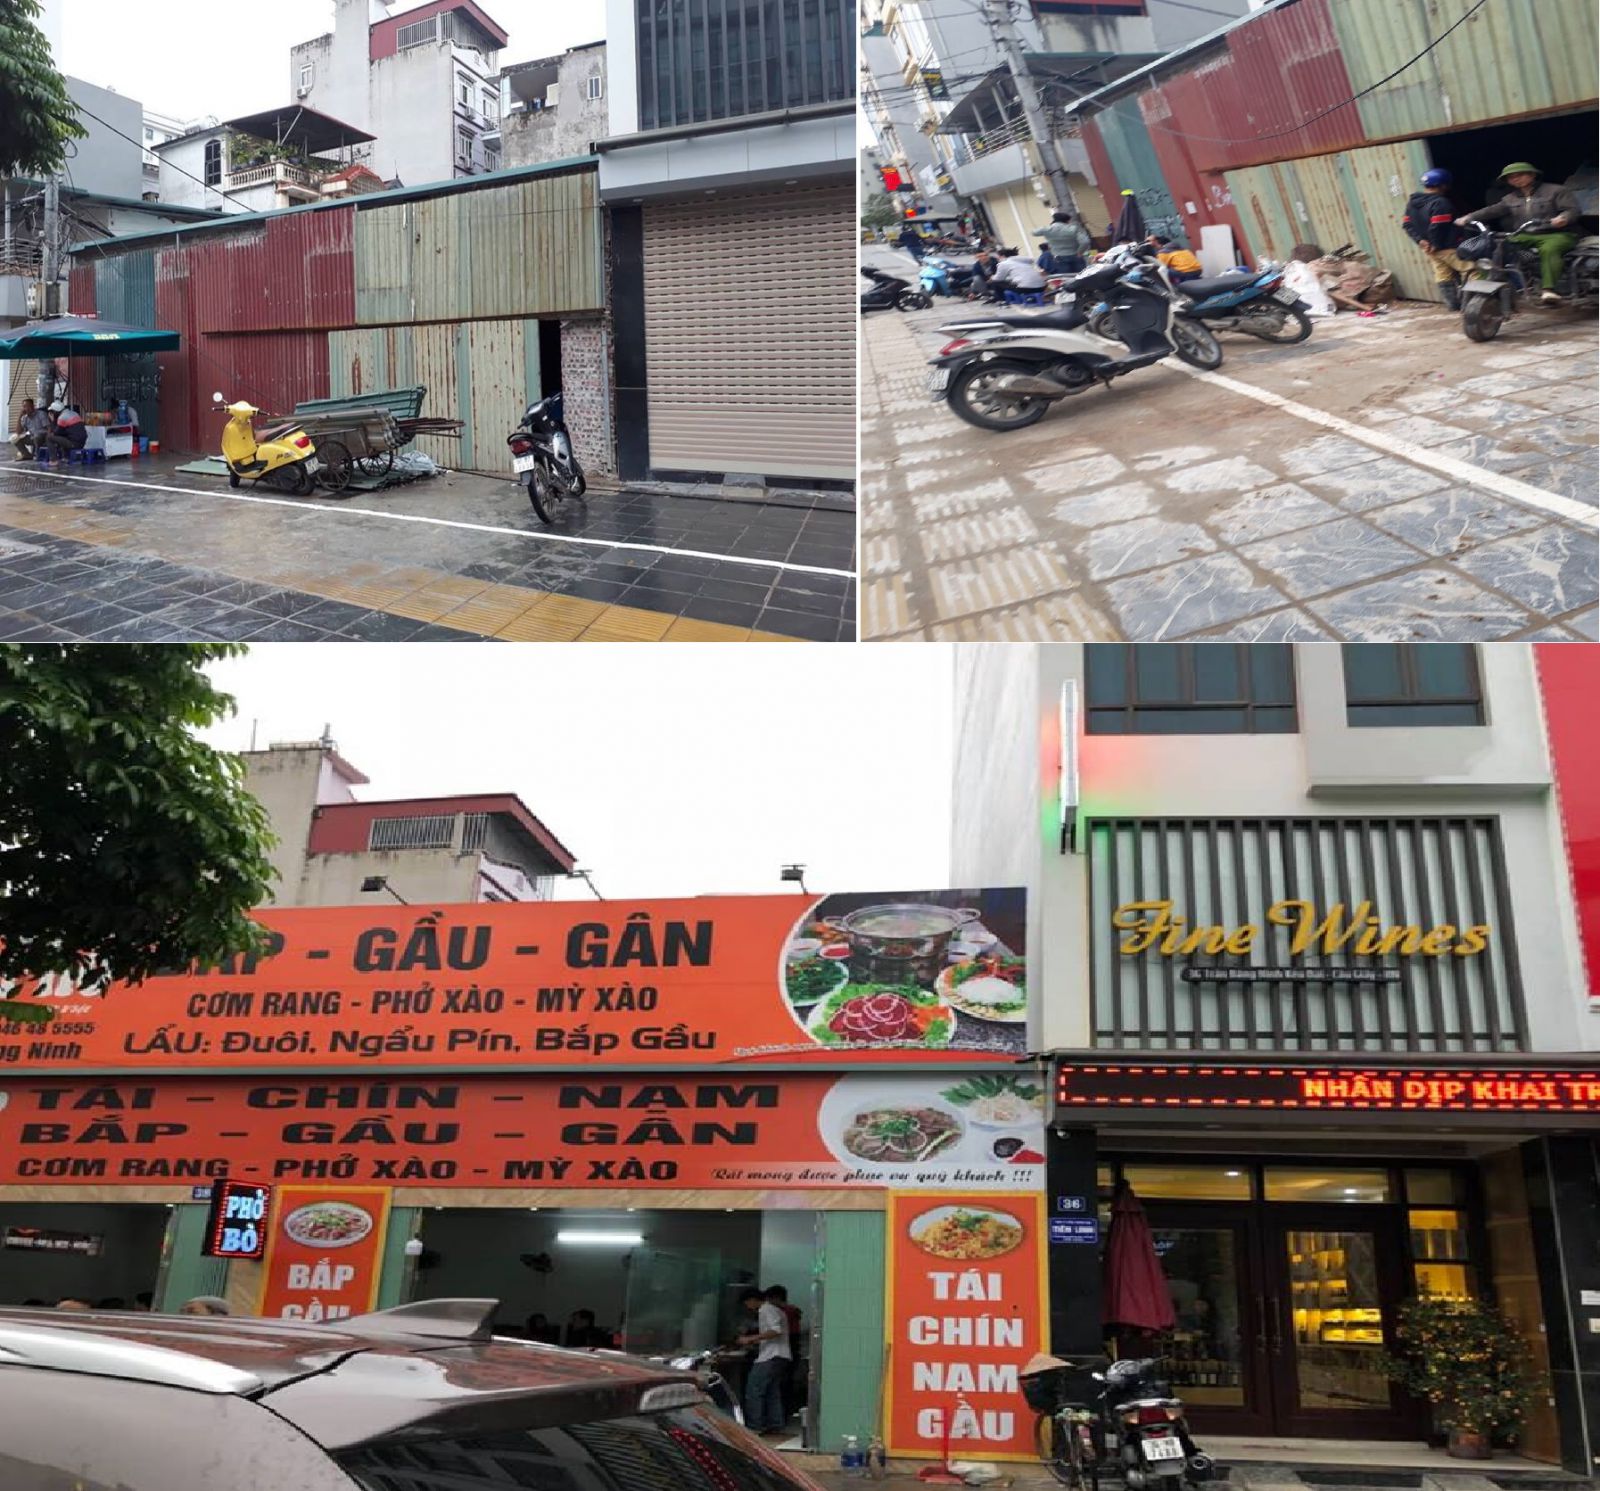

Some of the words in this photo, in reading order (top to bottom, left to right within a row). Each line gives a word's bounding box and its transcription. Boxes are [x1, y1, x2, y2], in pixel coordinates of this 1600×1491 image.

[353, 911, 492, 972] GẦU
[565, 912, 713, 968] GÂN
[1112, 899, 1257, 956] Fine
[1268, 899, 1490, 956] Wines
[187, 990, 254, 1018] CƠM
[261, 991, 341, 1017] RANG
[371, 981, 435, 1015] PHỞ
[441, 984, 504, 1014] XÀO
[536, 982, 584, 1013] MỲ
[594, 982, 657, 1013] XÀO
[28, 1042, 82, 1059] Ninh
[536, 1024, 619, 1055] Bắp
[632, 1024, 717, 1050] Gầu
[29, 1084, 155, 1111] TÁI
[247, 1082, 460, 1109] CHÍN
[1304, 1075, 1395, 1098] NHÂN
[1404, 1080, 1465, 1103] DỊP
[1472, 1081, 1556, 1100] KHAI
[20, 1114, 189, 1144] BẮP
[282, 1115, 460, 1145] GẦU
[561, 1117, 759, 1146] GÂN
[18, 1157, 107, 1177] CƠM
[120, 1159, 230, 1178] RANG
[273, 1153, 357, 1179] PHỞ
[372, 1156, 457, 1179] XÀO
[504, 1156, 572, 1179] MỲ
[587, 1157, 678, 1179] XÀO
[226, 1188, 265, 1220] PHỞ
[221, 1221, 258, 1252] BÒ
[288, 1257, 354, 1290] BẮP
[926, 1268, 1002, 1301] TÁI
[908, 1313, 1023, 1348] CHÍN
